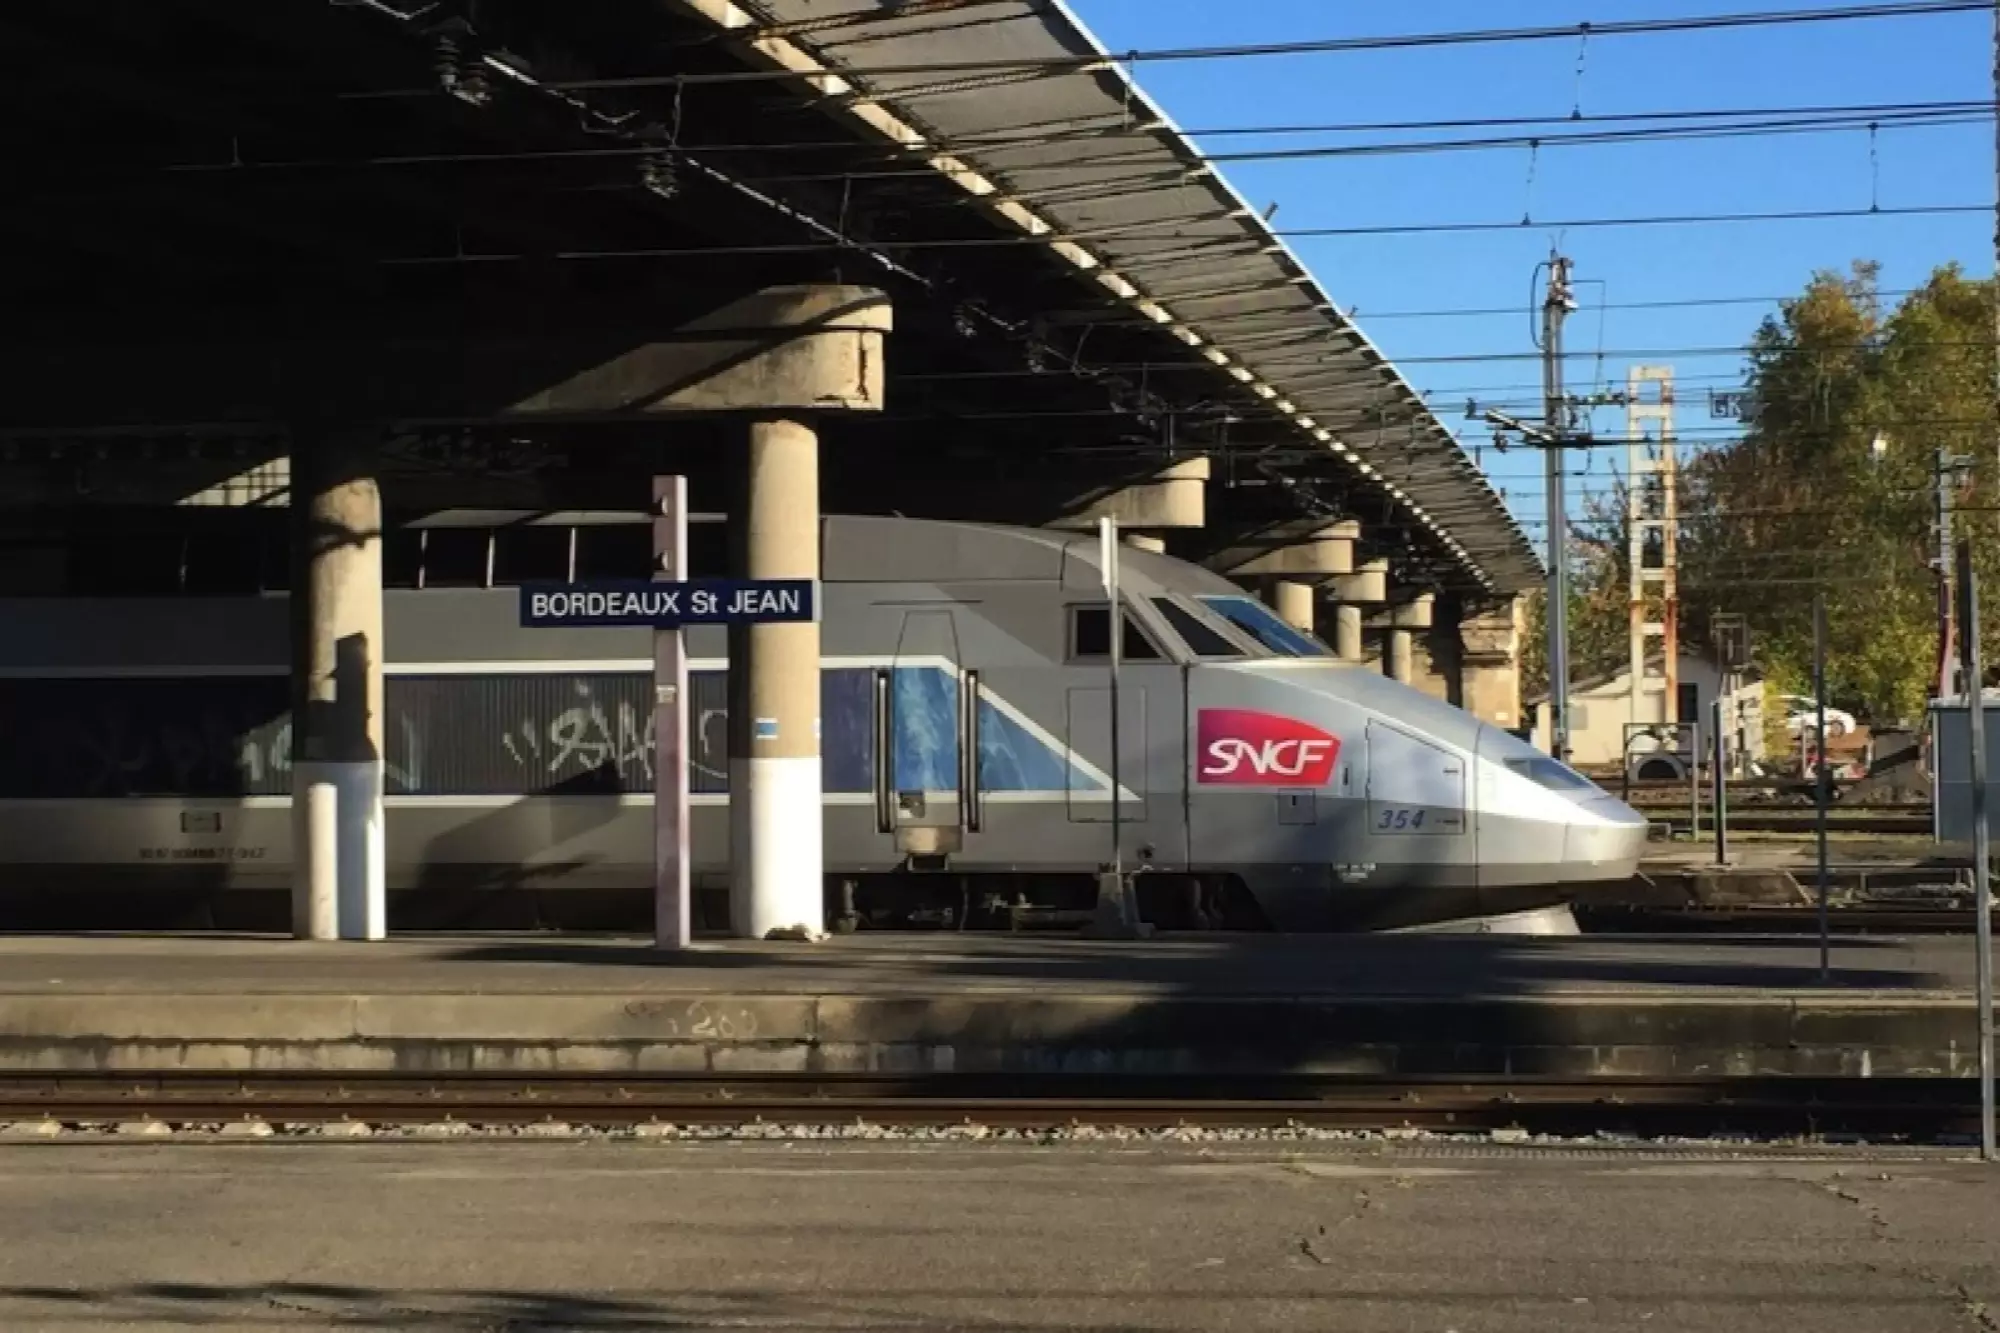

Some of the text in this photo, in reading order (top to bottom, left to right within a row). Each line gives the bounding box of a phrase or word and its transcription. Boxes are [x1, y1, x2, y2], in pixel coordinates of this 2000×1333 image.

[531, 589, 800, 616] BORDEAUX St JEAN
[1203, 739, 1333, 775] SNCF
[1377, 809, 1427, 829] 354
